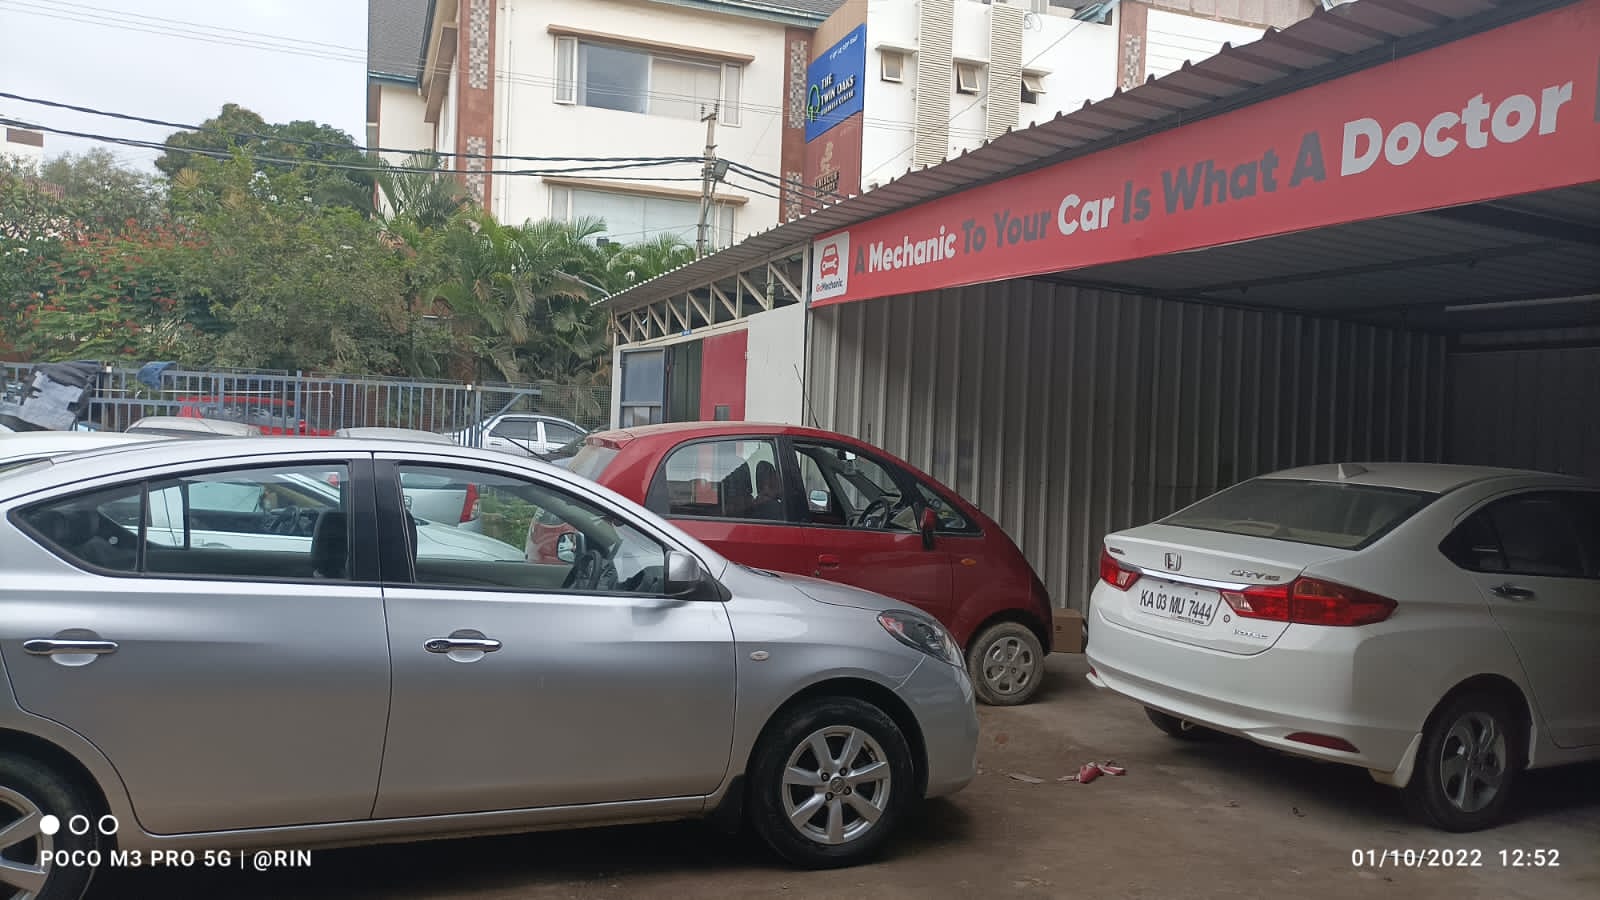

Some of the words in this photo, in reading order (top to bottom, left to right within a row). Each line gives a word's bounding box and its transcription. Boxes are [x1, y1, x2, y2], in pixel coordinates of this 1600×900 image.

[837, 75, 854, 94] OAKS
[854, 246, 865, 275] A
[868, 226, 957, 273] Mechanic
[961, 219, 986, 254] To
[993, 210, 1051, 248] Your
[1057, 194, 1115, 236] Car
[1121, 181, 1151, 224] Is
[1162, 148, 1279, 214] What
[1288, 131, 1327, 188] A
[1340, 81, 1573, 177] Doctor
[1140, 590, 1154, 608] KA
[1156, 593, 1167, 610] 03
[1169, 596, 1186, 614] MU
[1188, 600, 1213, 621] 7444
